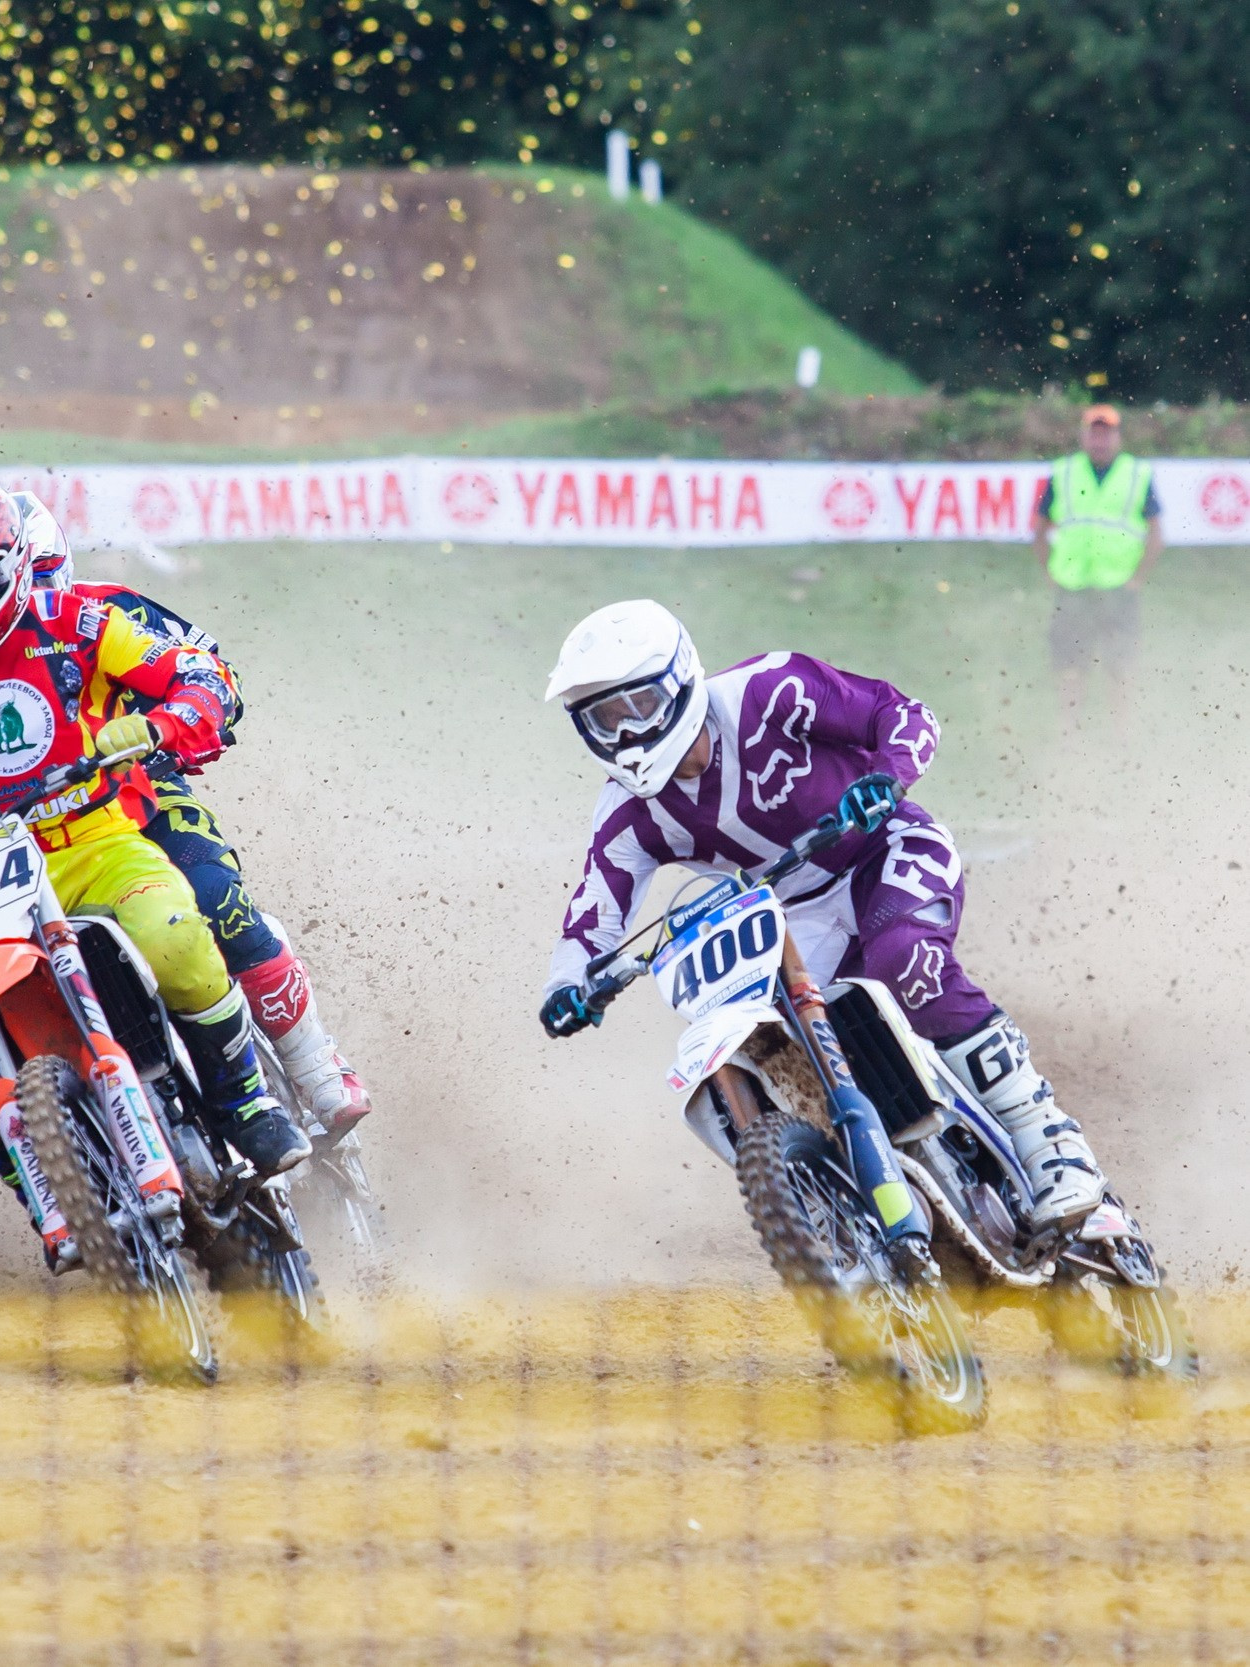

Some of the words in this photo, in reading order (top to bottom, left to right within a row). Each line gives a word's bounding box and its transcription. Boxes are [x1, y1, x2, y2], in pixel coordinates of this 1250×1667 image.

[189, 473, 410, 536] YAMAHA
[515, 471, 766, 531] YAMAHA
[894, 475, 1050, 532] YAM
[0, 682, 42, 702] КЛЕЕВОЙ
[41, 705, 53, 739] ЗАВОД
[23, 786, 90, 825] ZUKI
[685, 883, 732, 920] Husqvarna
[672, 909, 778, 1009] 400
[111, 1095, 139, 1153] ATHENA
[24, 1153, 57, 1214] ATHENA
